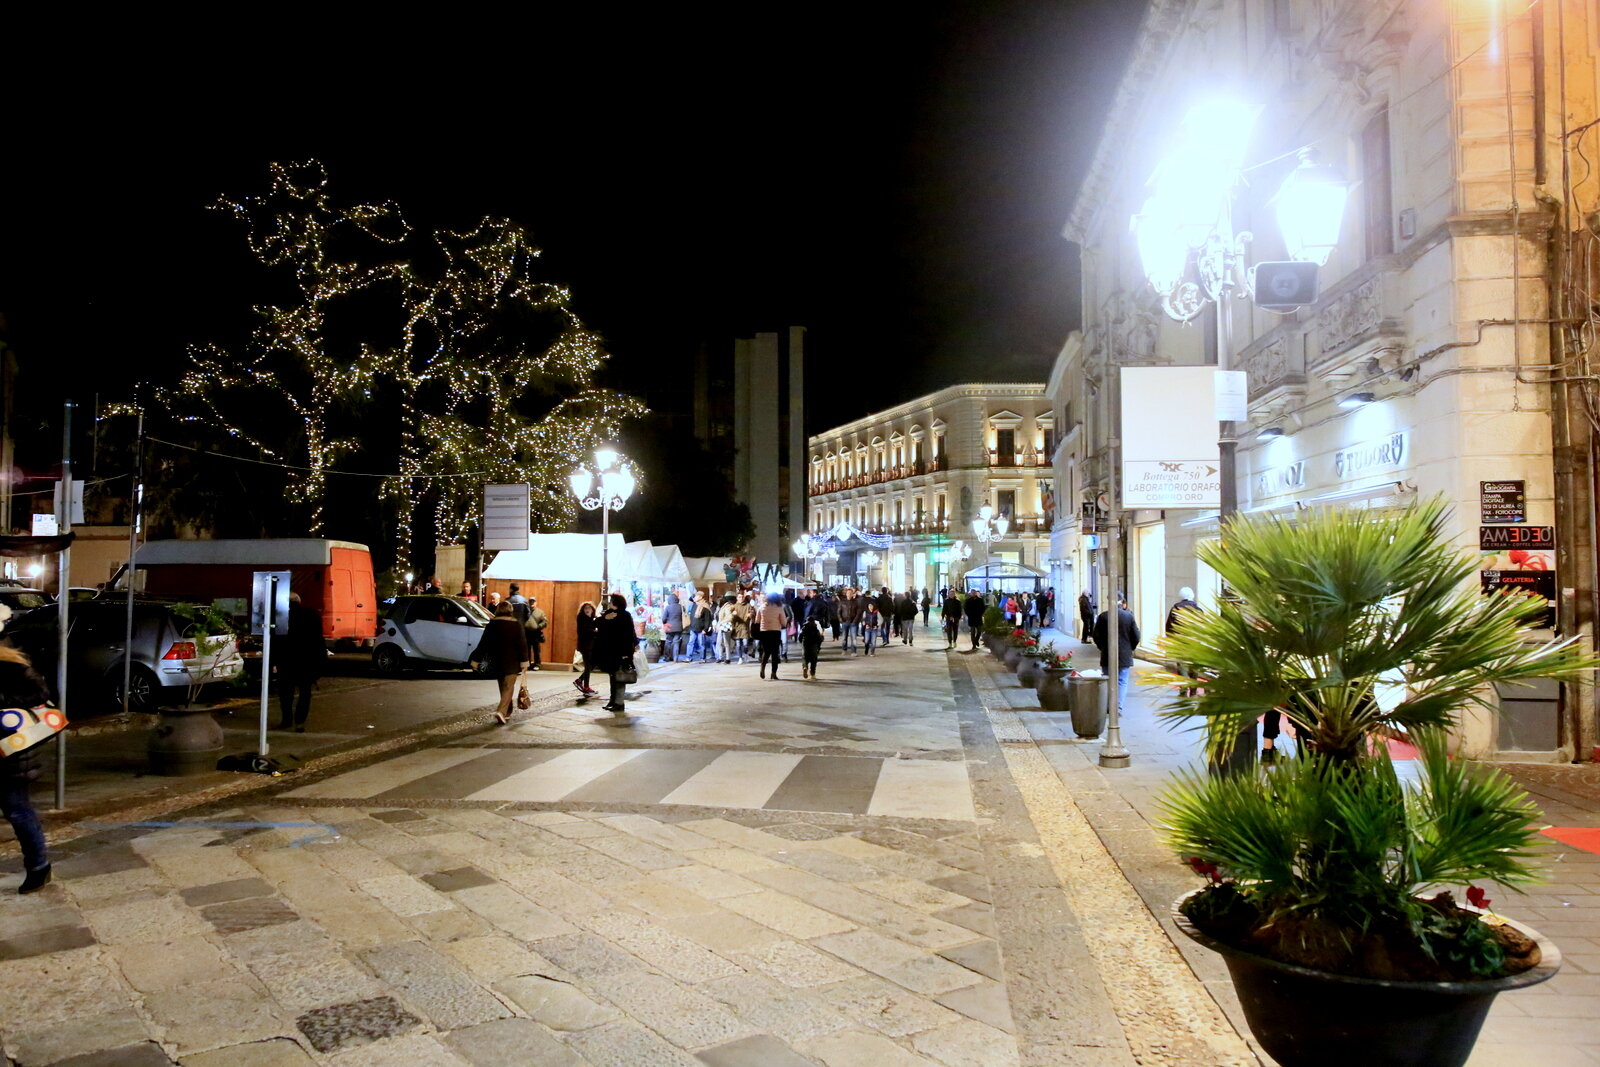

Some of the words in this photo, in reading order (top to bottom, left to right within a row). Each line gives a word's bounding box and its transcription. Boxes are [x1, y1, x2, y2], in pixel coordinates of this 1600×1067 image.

[1347, 443, 1390, 471] TUDOR
[1143, 472, 1180, 481] Bottega
[1184, 471, 1201, 480] 750
[1128, 483, 1189, 492] LABORATORIO
[1191, 483, 1221, 491] ORAFO
[1184, 493, 1204, 501] ORO
